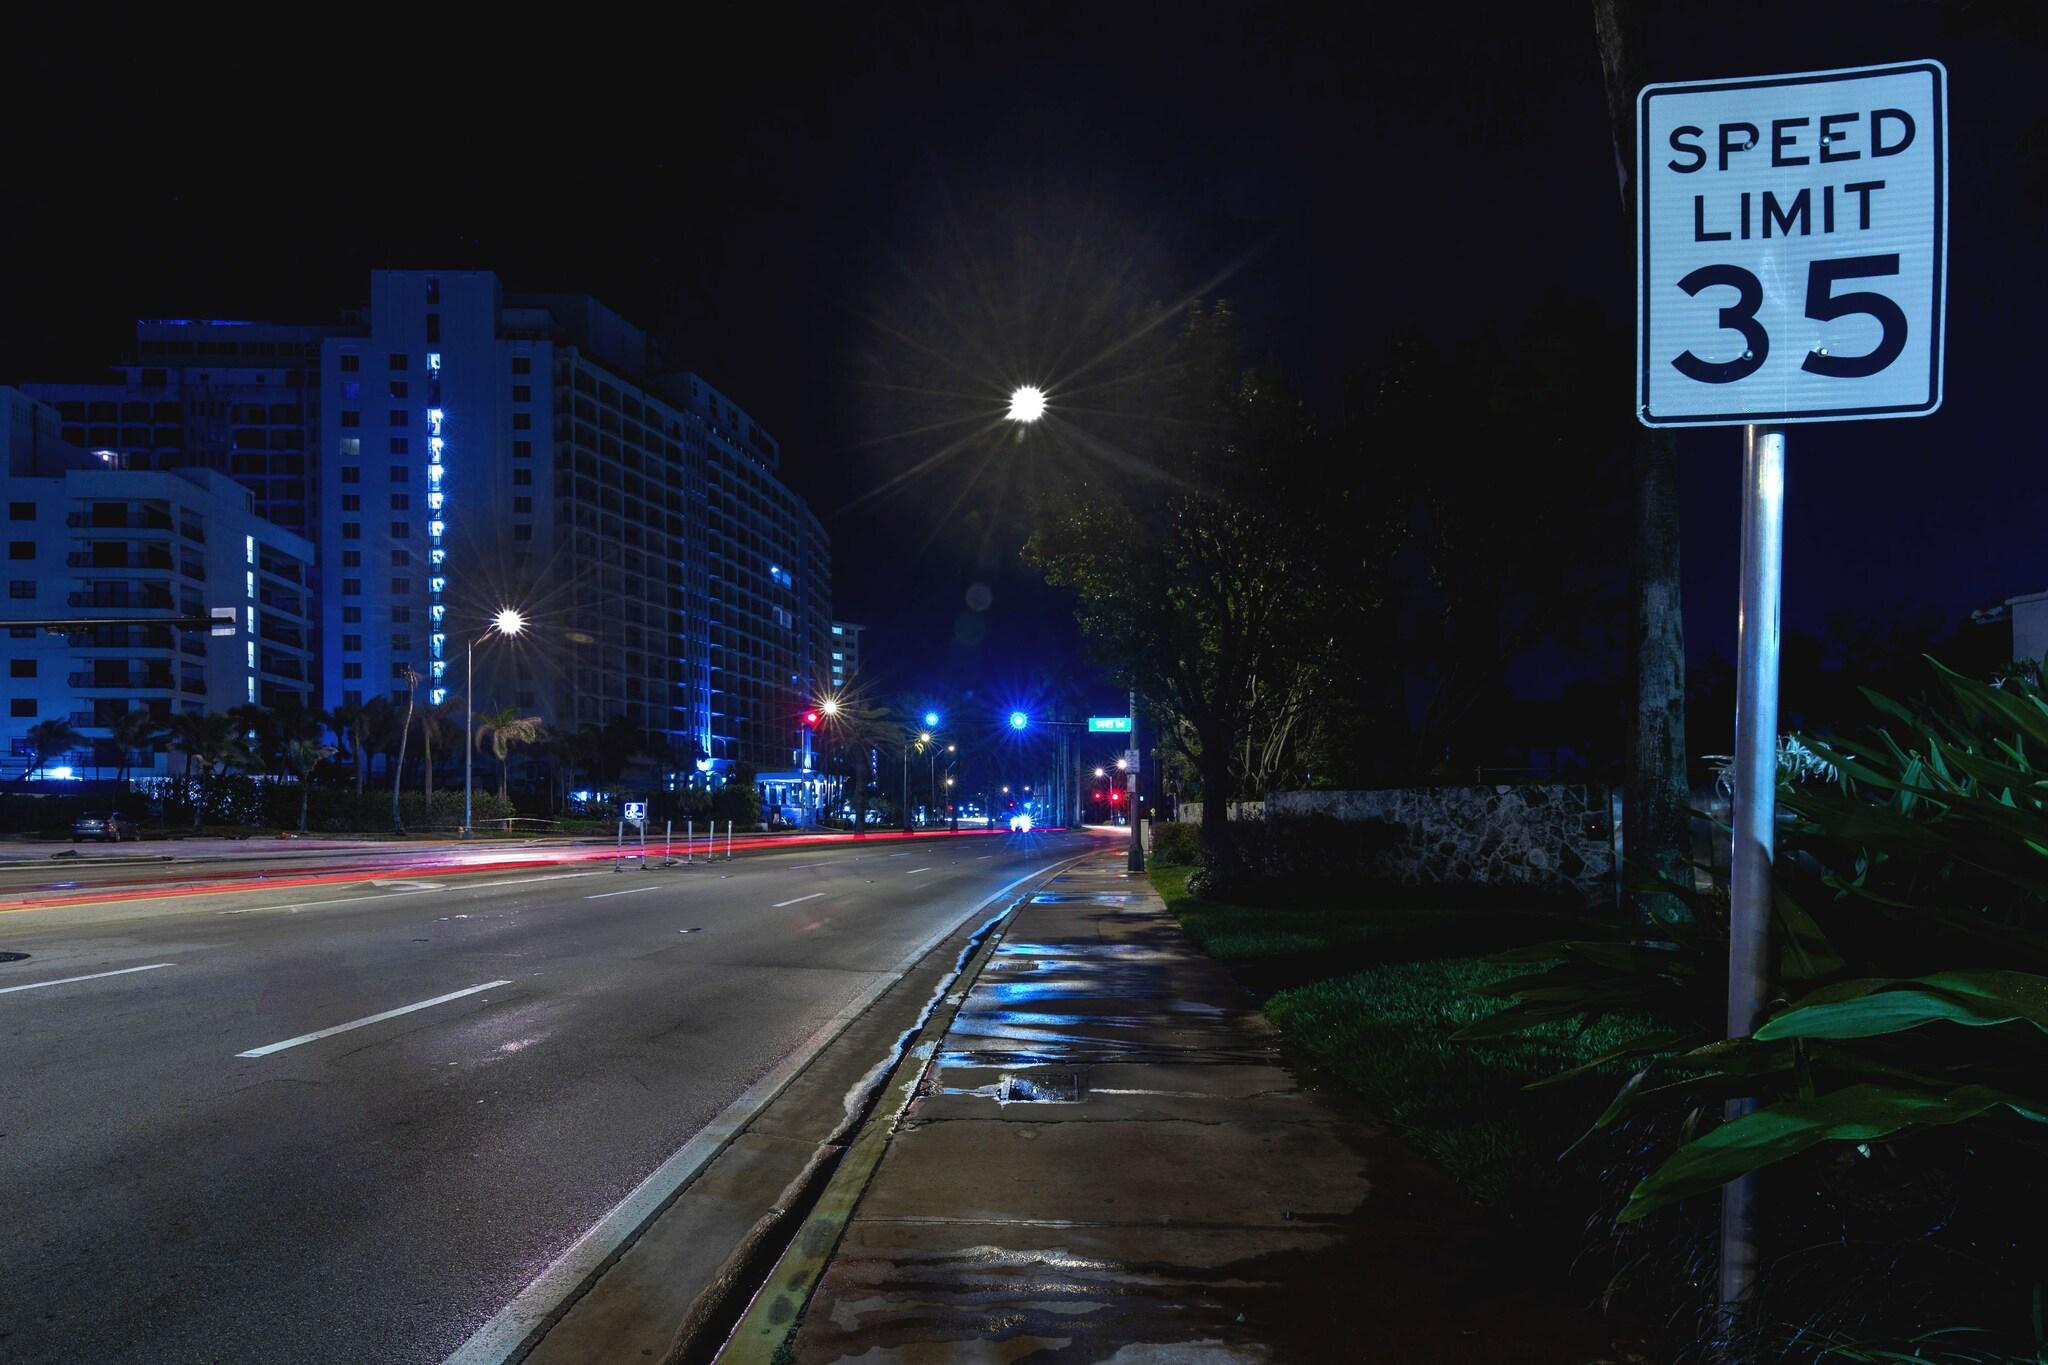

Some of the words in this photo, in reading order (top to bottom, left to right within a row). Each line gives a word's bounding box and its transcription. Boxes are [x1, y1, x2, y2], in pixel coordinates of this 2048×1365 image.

[1668, 108, 1916, 174] SPEED
[1694, 180, 1886, 242] LIMIT
[1671, 253, 1909, 384] 35
